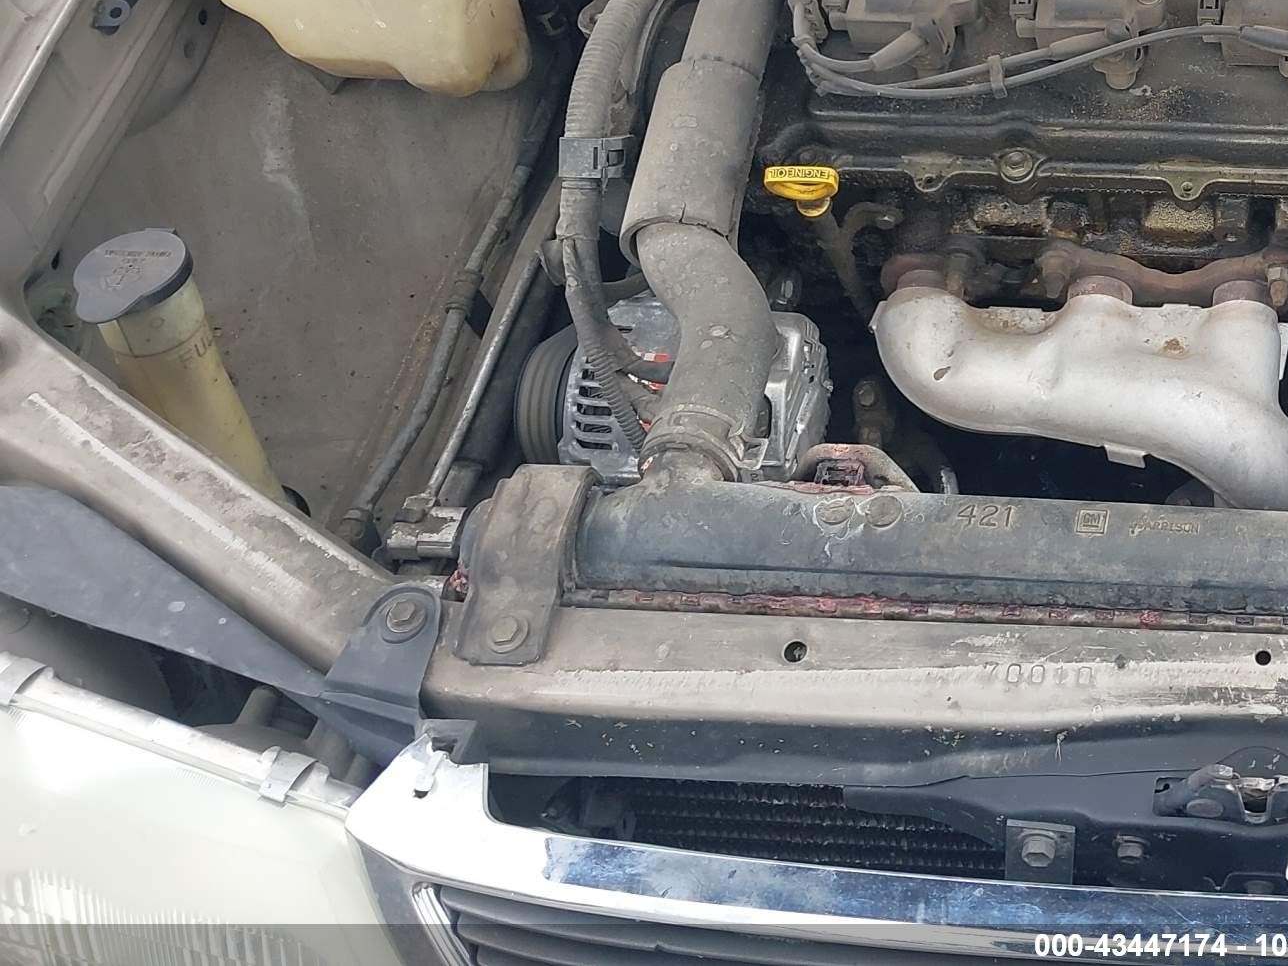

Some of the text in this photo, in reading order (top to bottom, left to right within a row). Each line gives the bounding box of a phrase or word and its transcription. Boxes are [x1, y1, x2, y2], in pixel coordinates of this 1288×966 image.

[768, 167, 830, 179] ENGINE OIL
[957, 505, 1013, 528] 421
